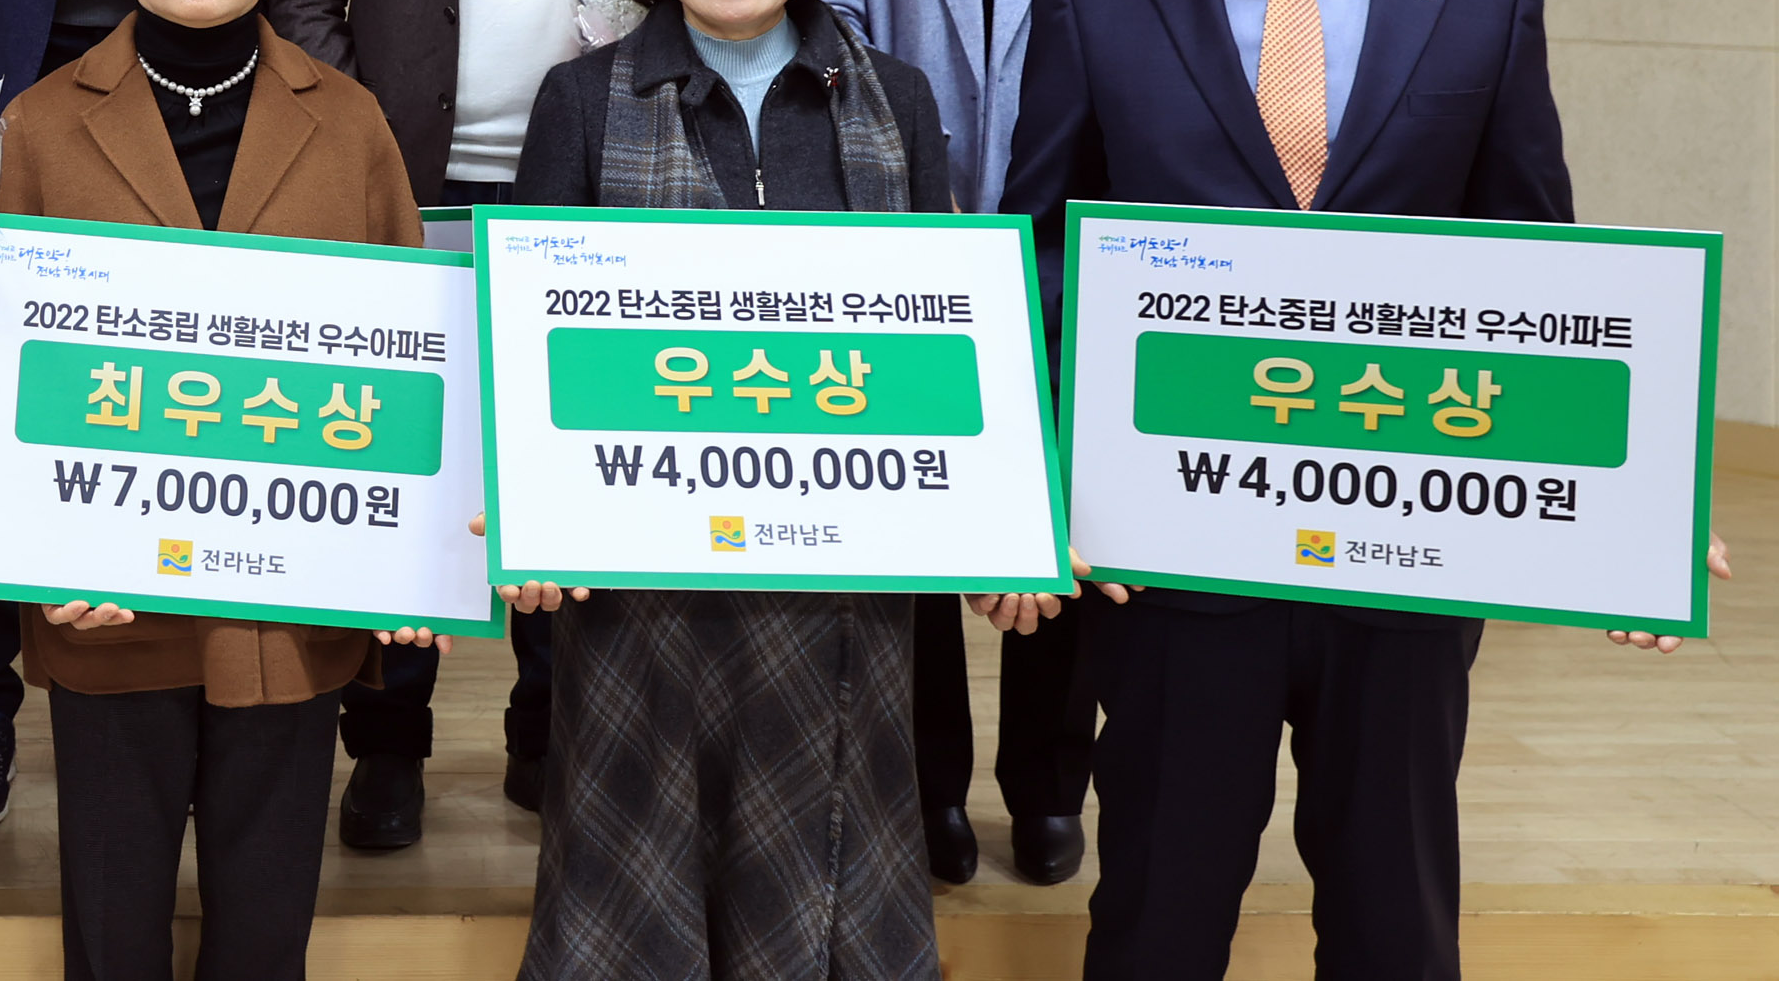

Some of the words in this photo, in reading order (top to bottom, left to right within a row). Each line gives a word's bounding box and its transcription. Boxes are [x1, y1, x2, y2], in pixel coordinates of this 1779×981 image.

[37, 266, 61, 277] 전남
[553, 254, 577, 265] 전남
[1150, 256, 1177, 267] 전남
[545, 289, 612, 316] 2022
[618, 289, 722, 321] 탄소중립
[729, 290, 834, 323] 생활실천
[842, 293, 973, 324] 우수아파트
[1138, 291, 1211, 323] 2022
[1219, 294, 1336, 332] 탄소중립
[1345, 302, 1466, 340] 생활실천
[1476, 309, 1633, 349] 우수아파트
[23, 300, 89, 332] 2022
[96, 304, 199, 344] 탄소중립
[206, 314, 310, 353] 생활실천
[317, 323, 446, 363] 우수아파트
[654, 346, 872, 416] 우수상
[85, 360, 382, 451] 최우수상
[1250, 357, 1502, 437] 우수상
[755, 523, 842, 547] 전라남도
[201, 549, 286, 576] 전라남도
[1345, 540, 1444, 568] 전라남도
